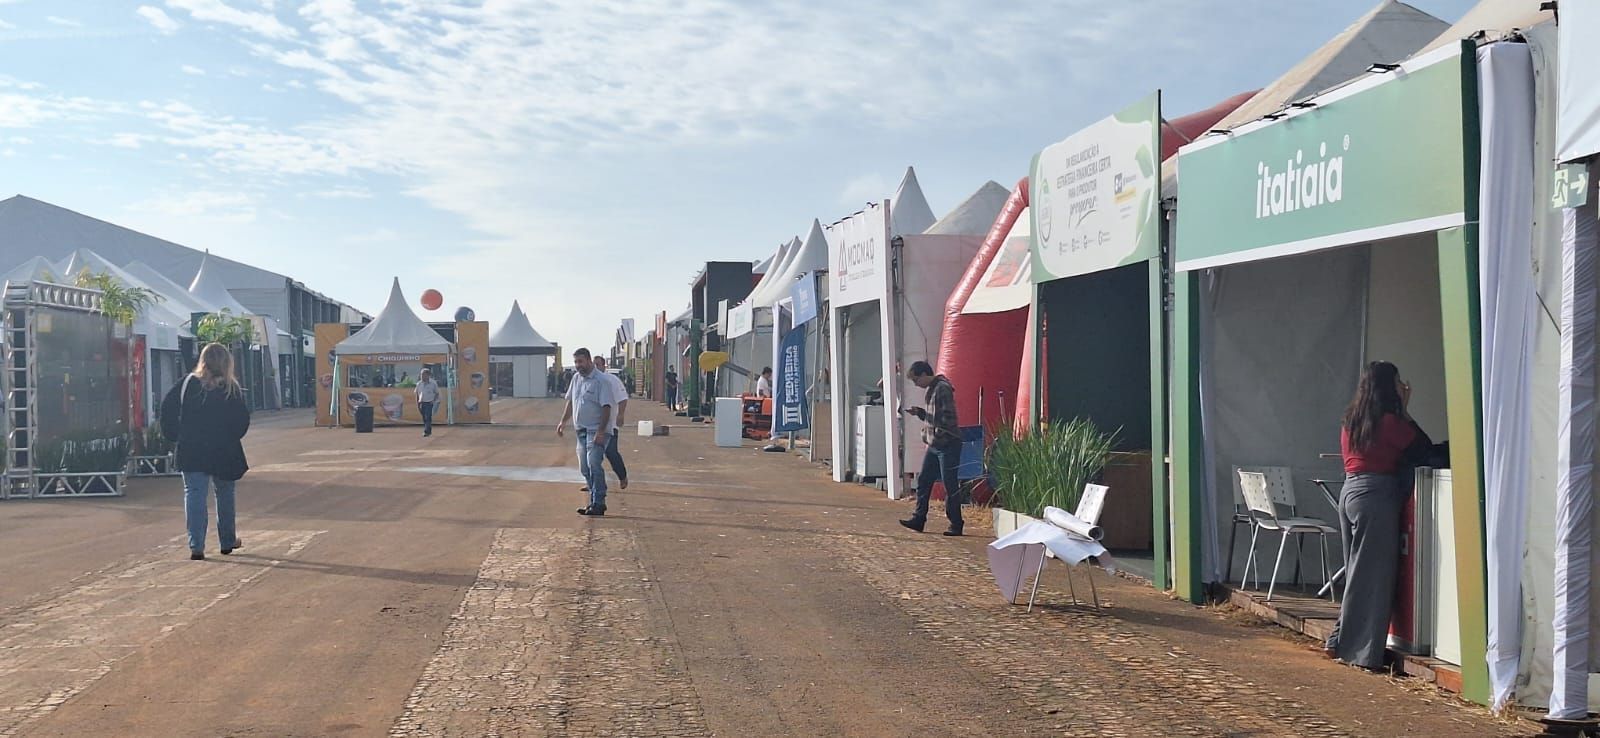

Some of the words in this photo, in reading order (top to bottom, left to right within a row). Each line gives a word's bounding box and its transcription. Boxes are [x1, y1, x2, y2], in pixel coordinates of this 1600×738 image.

[1099, 156, 1111, 172] CERTA
[1256, 142, 1343, 218] itatiaia
[785, 346, 794, 403] PEDREIRA
